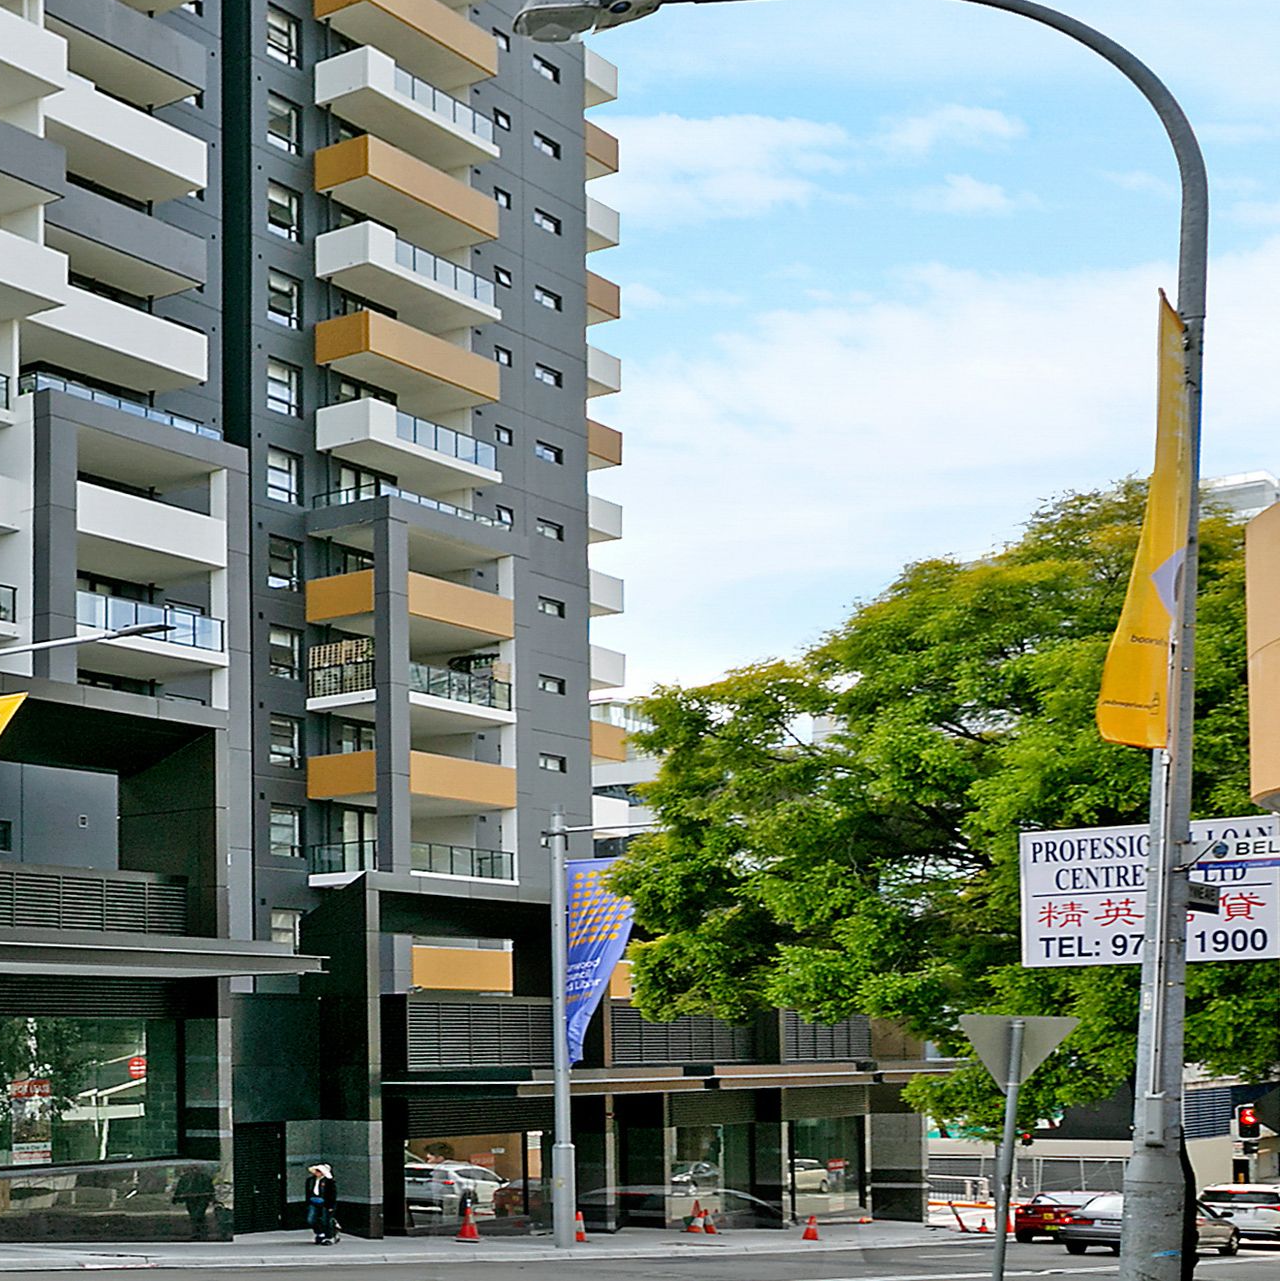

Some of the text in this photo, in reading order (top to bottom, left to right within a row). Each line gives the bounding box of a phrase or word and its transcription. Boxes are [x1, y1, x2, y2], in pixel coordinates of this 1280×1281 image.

[1032, 832, 1194, 864] PROFESSIO
[1236, 841, 1280, 856] BEL
[1055, 864, 1145, 891] CENTRE
[1039, 934, 1100, 958] TEL:
[1195, 928, 1268, 952] 1900
